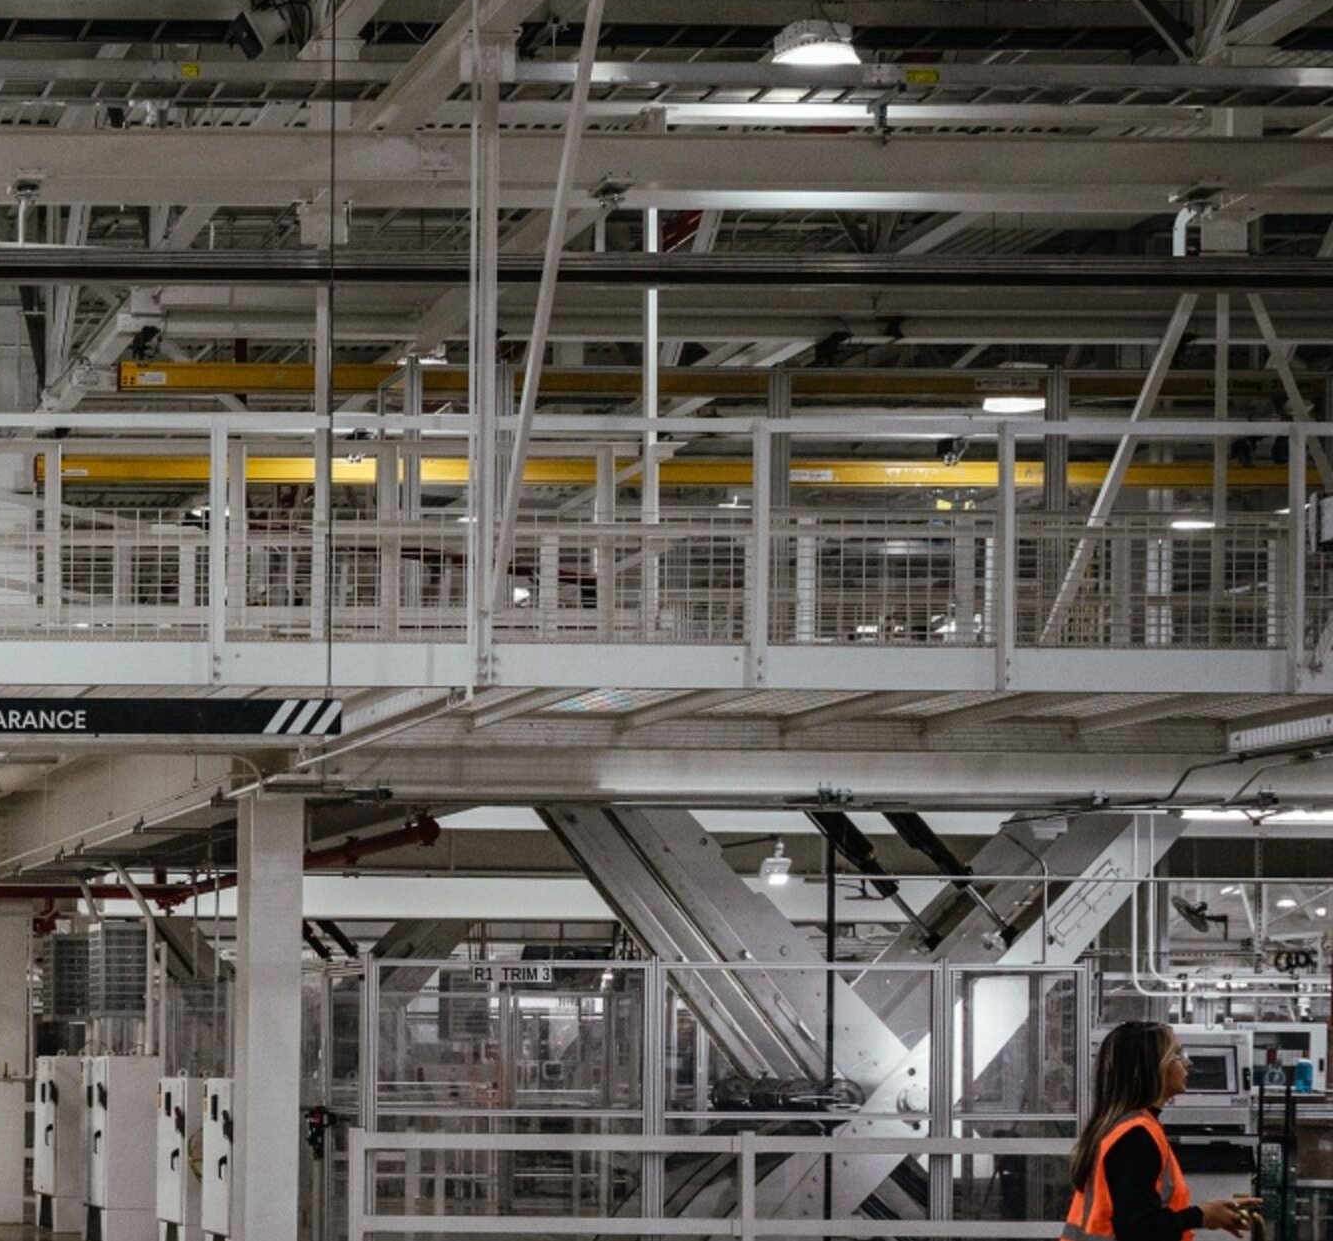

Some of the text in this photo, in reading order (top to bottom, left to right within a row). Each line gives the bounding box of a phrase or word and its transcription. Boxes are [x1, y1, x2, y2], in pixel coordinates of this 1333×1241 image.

[474, 967, 550, 980] R1 TRIM 3
